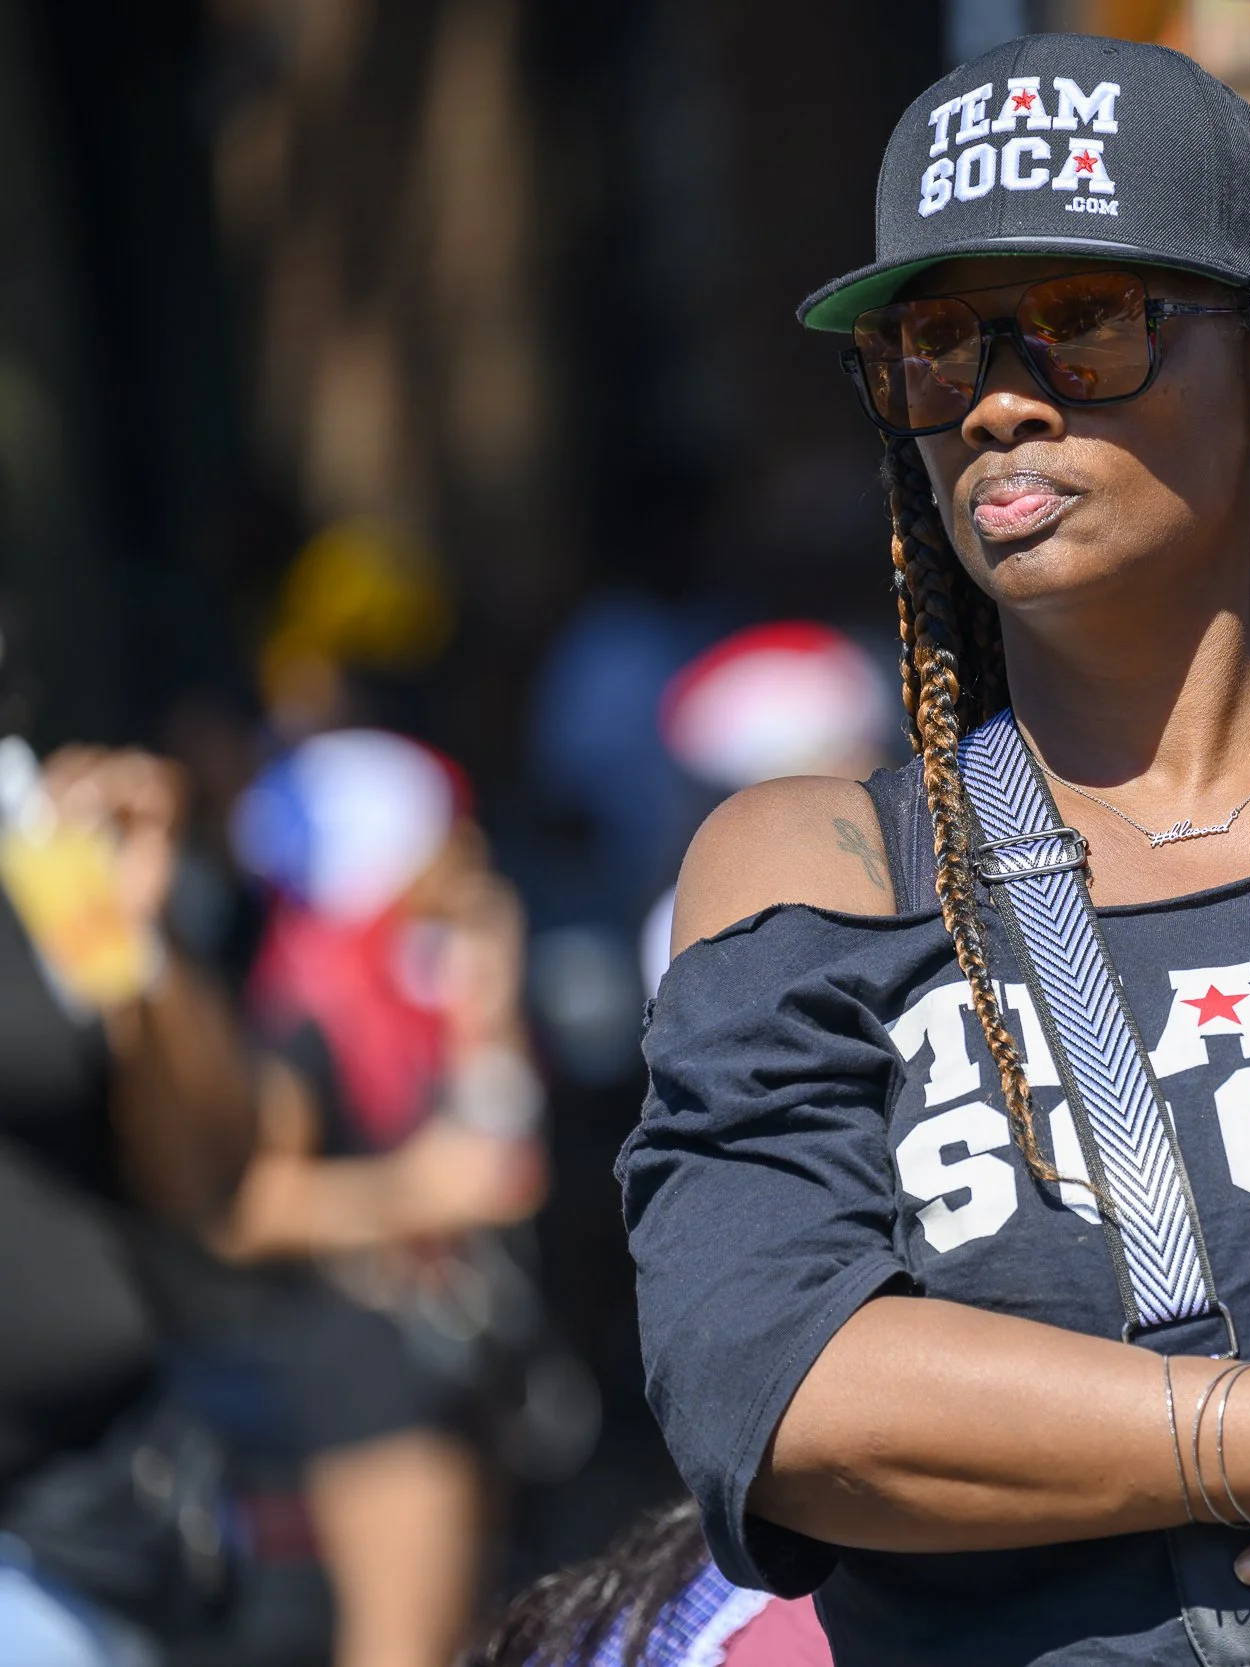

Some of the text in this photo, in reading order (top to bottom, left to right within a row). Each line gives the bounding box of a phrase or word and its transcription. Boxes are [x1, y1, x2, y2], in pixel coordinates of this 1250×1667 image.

[928, 77, 1121, 158] TEAM
[919, 138, 1115, 218] SOCA
[1065, 197, 1118, 216] .COM
